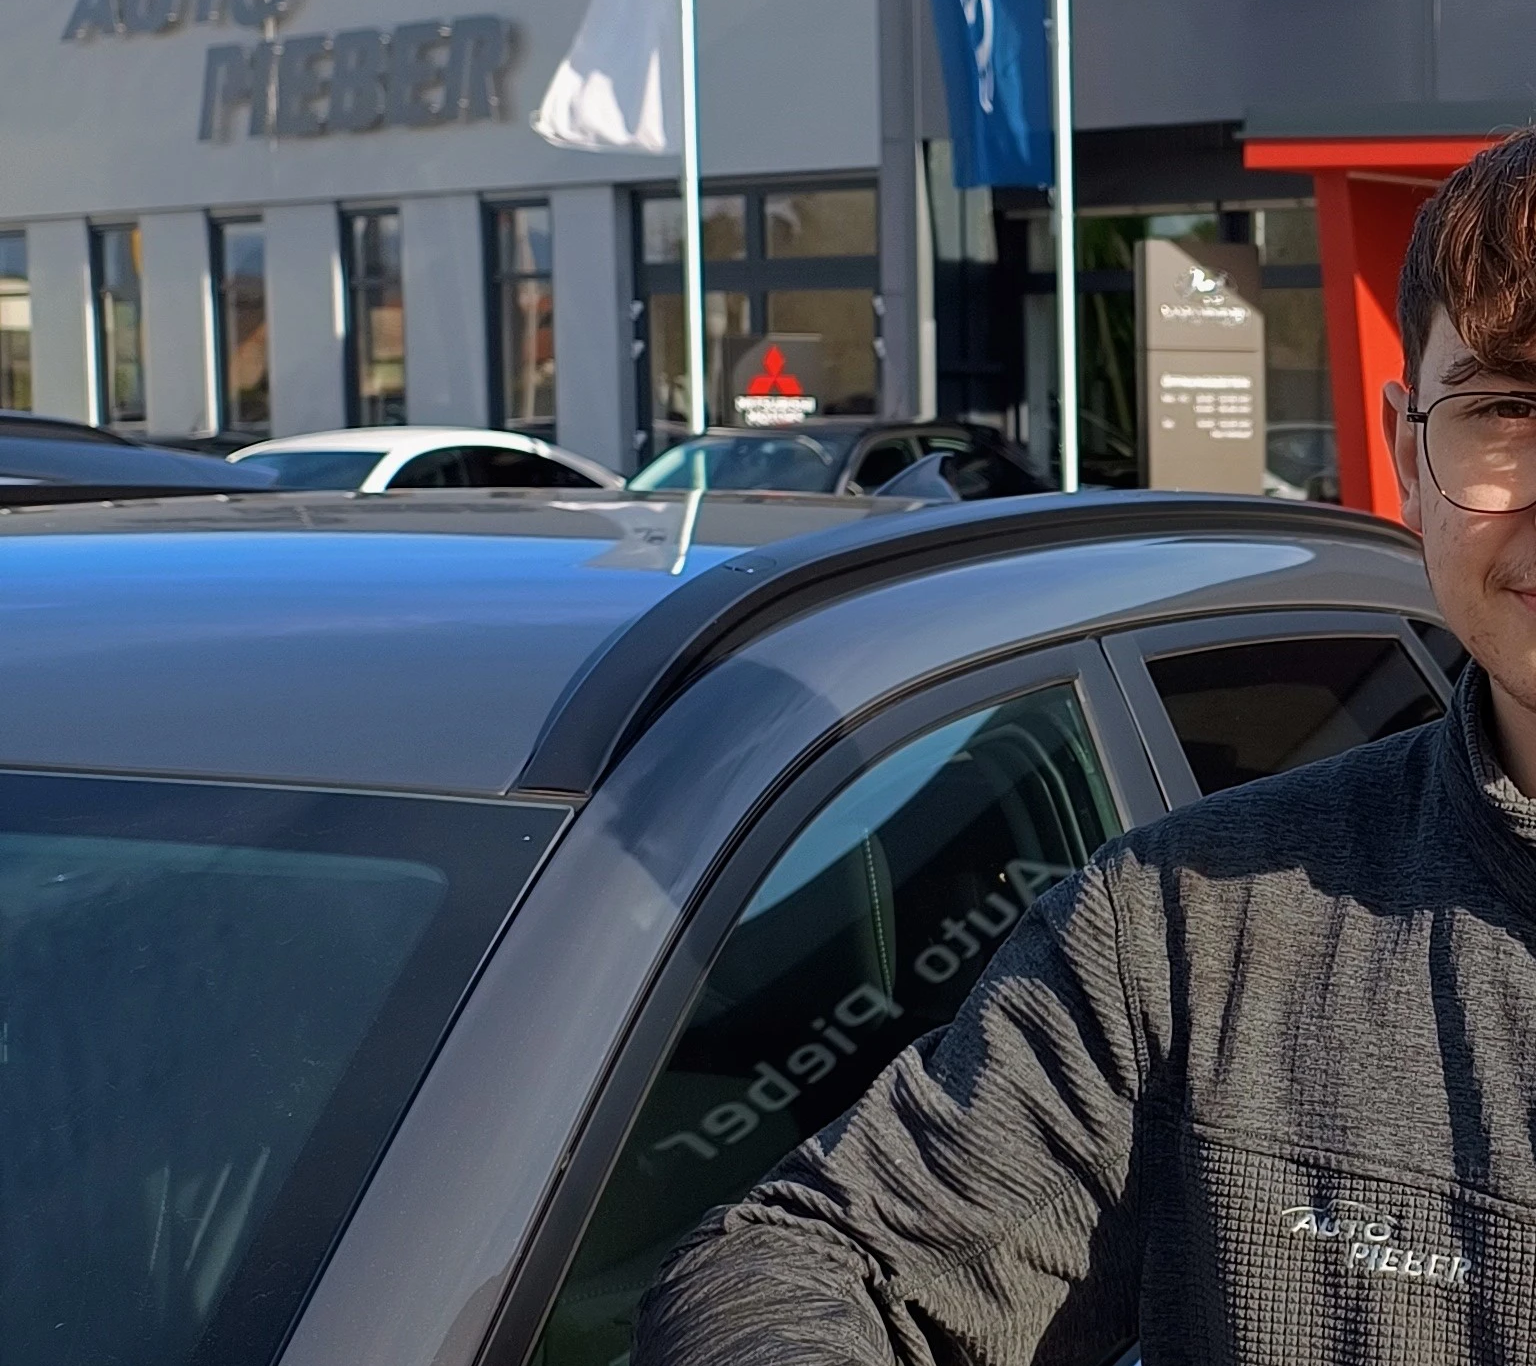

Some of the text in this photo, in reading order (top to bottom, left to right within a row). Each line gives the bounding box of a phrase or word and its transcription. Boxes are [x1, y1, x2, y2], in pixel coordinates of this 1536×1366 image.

[198, 14, 508, 142] PIEBER
[1291, 1213, 1392, 1242] AUTO
[1347, 1241, 1472, 1285] PIEBER
